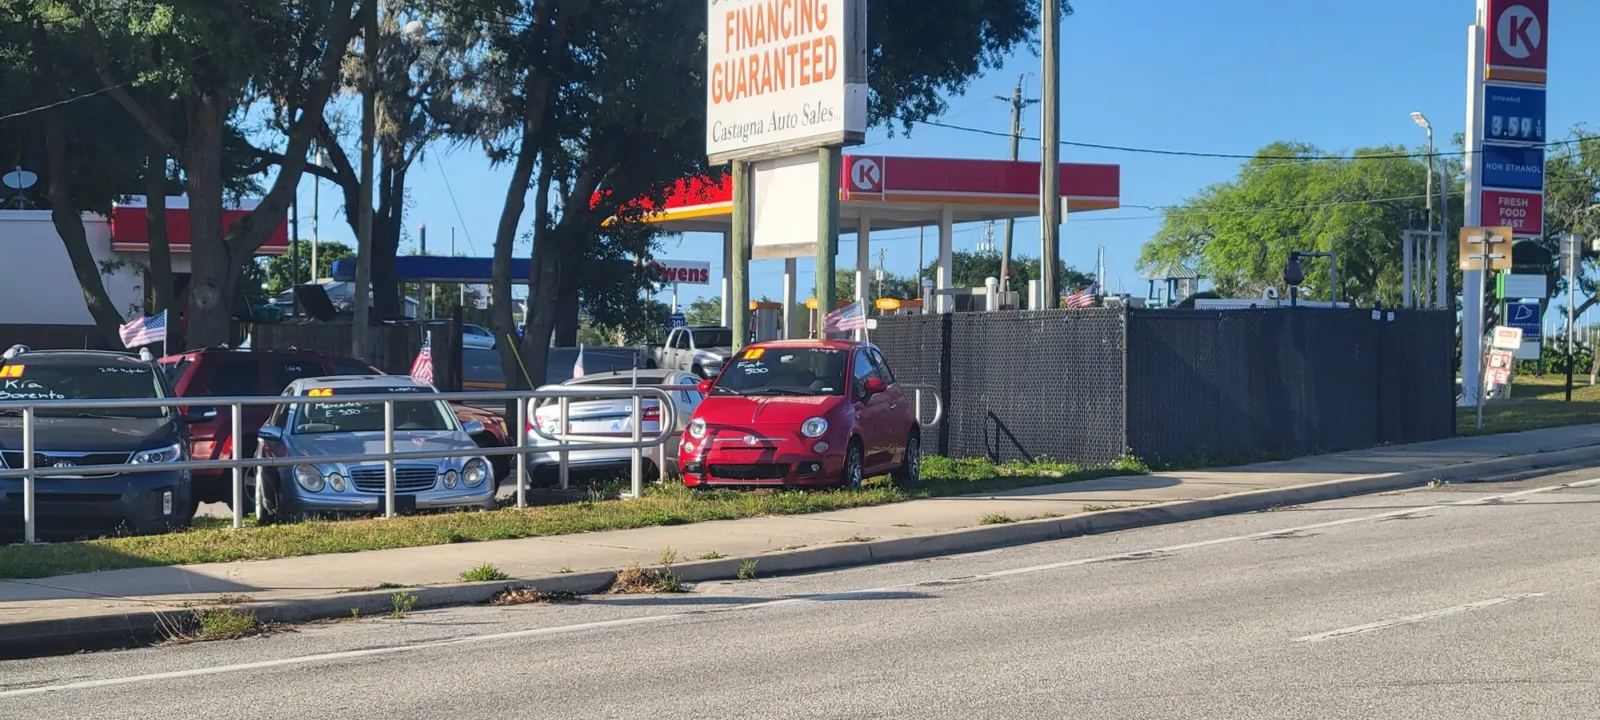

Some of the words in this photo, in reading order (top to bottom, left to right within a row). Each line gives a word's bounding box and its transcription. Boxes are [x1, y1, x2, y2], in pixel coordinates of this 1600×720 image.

[726, 0, 828, 53] FINANCING
[1509, 16, 1536, 55] K
[712, 35, 837, 104] GUARANTEED
[712, 119, 763, 143] Castagna
[767, 109, 798, 133] Auto
[801, 99, 834, 126] Sales
[1486, 162, 1503, 171] NON
[1505, 163, 1542, 173] ETHANOL
[859, 164, 877, 188] K
[1498, 196, 1529, 207] FRESH
[1499, 207, 1526, 217] FOOD
[1501, 218, 1524, 228] FAST
[737, 361, 764, 369] Fiat
[5, 379, 43, 388] Kia
